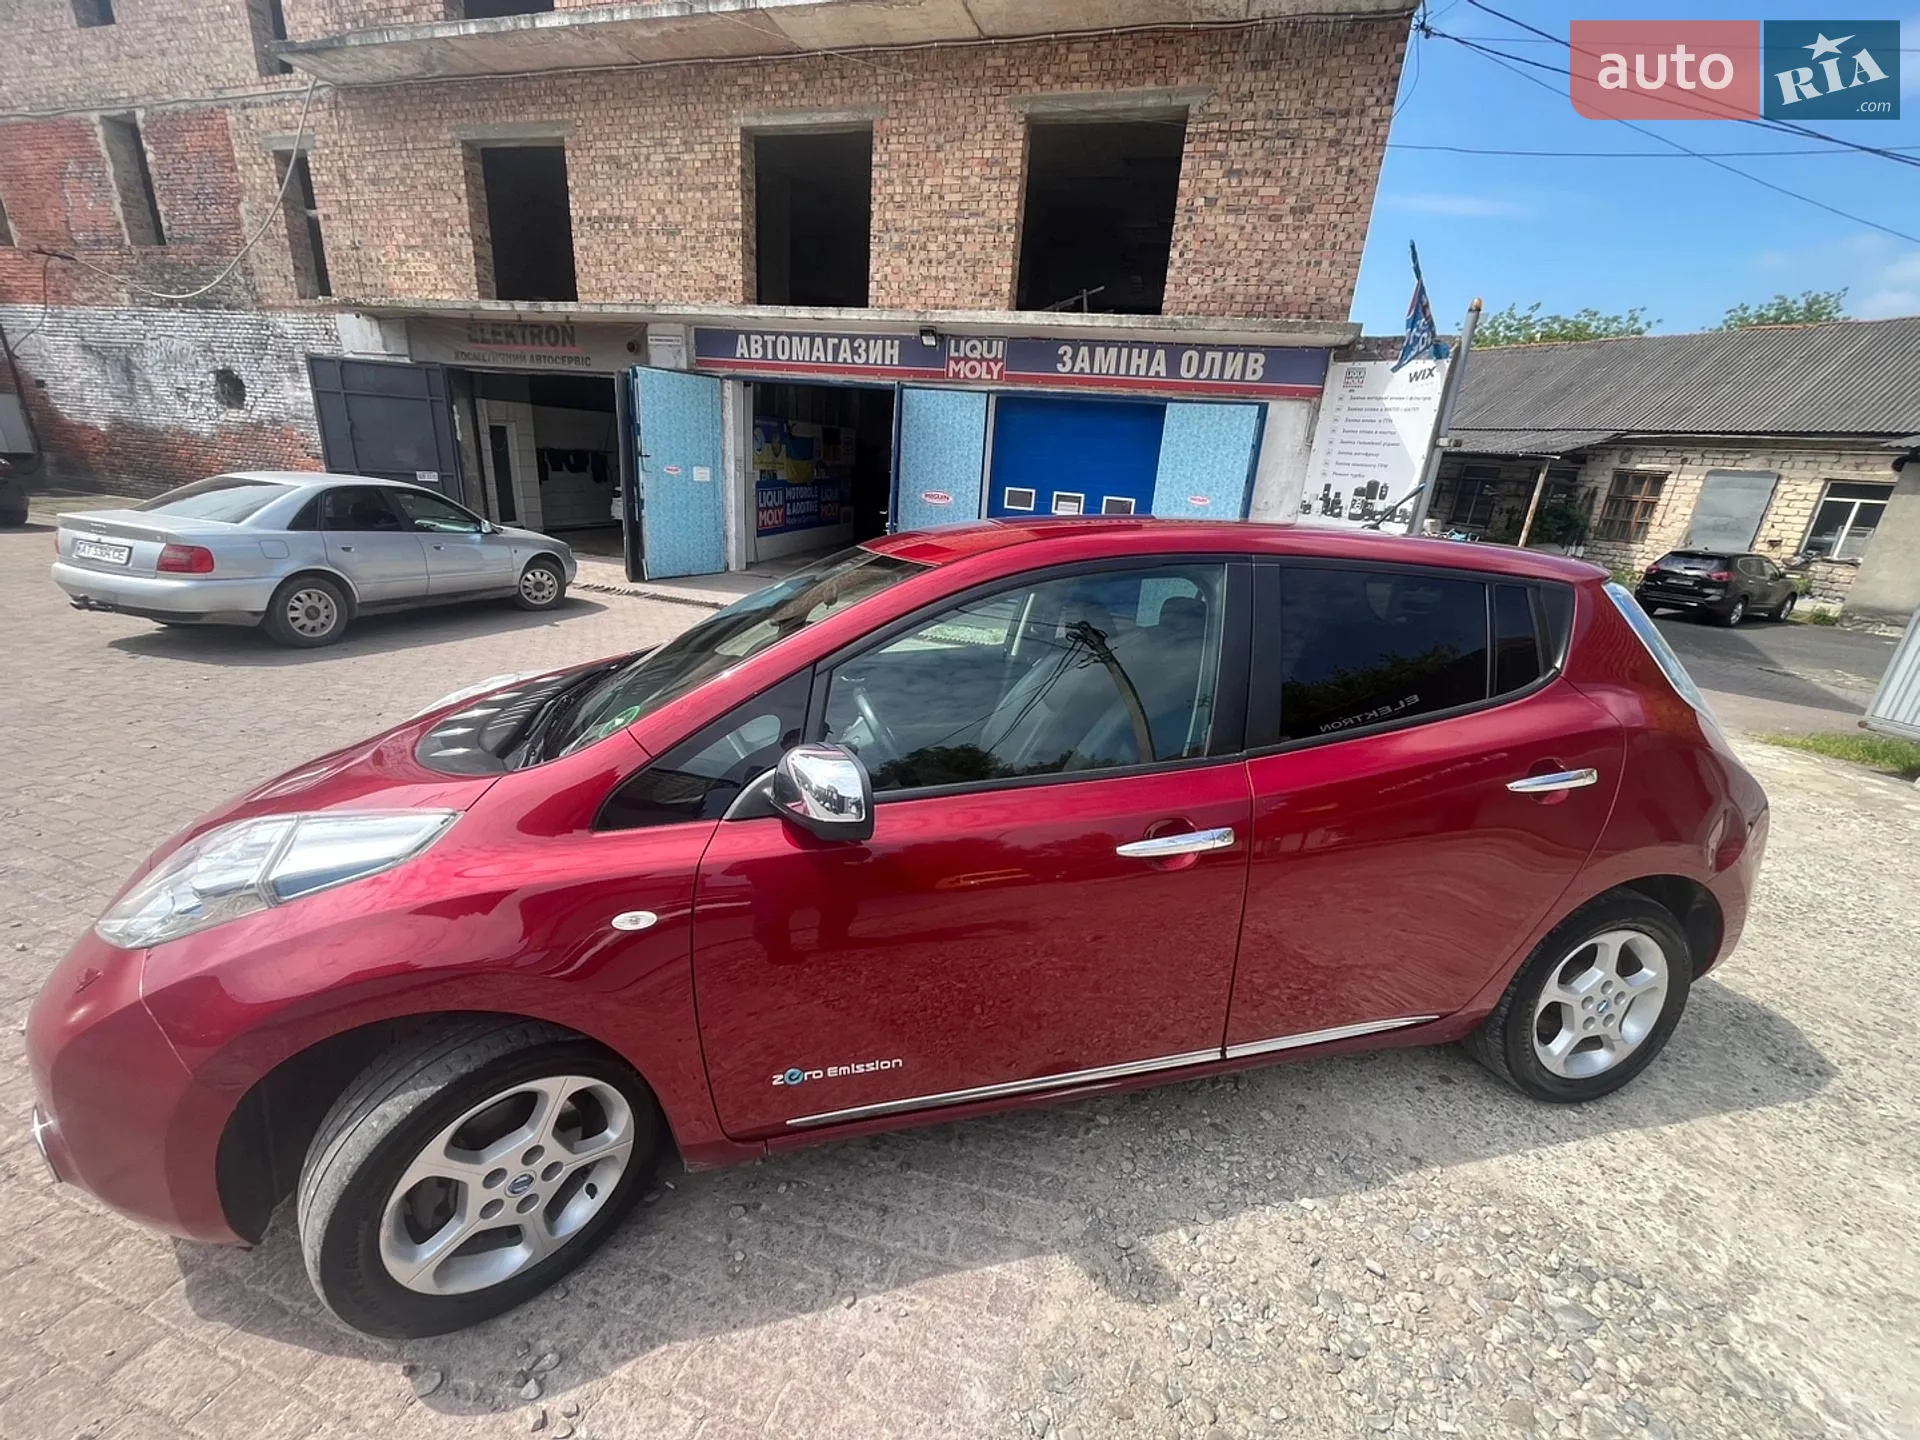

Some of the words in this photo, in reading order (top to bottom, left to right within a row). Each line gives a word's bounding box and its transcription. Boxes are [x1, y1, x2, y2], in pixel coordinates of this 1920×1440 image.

[467, 322, 576, 347] ELEKTRON
[735, 334, 900, 365] АВТОМАГАЗИН
[949, 339, 1003, 359] LIQUI
[948, 360, 1004, 379] MOLY
[1056, 345, 1167, 377] ЗАМІНА
[1180, 349, 1266, 381] ОЛИВ
[1409, 366, 1437, 383] WIX
[758, 489, 783, 507] LIQUI
[758, 508, 784, 527] MOLY
[827, 1058, 903, 1078] Emission
